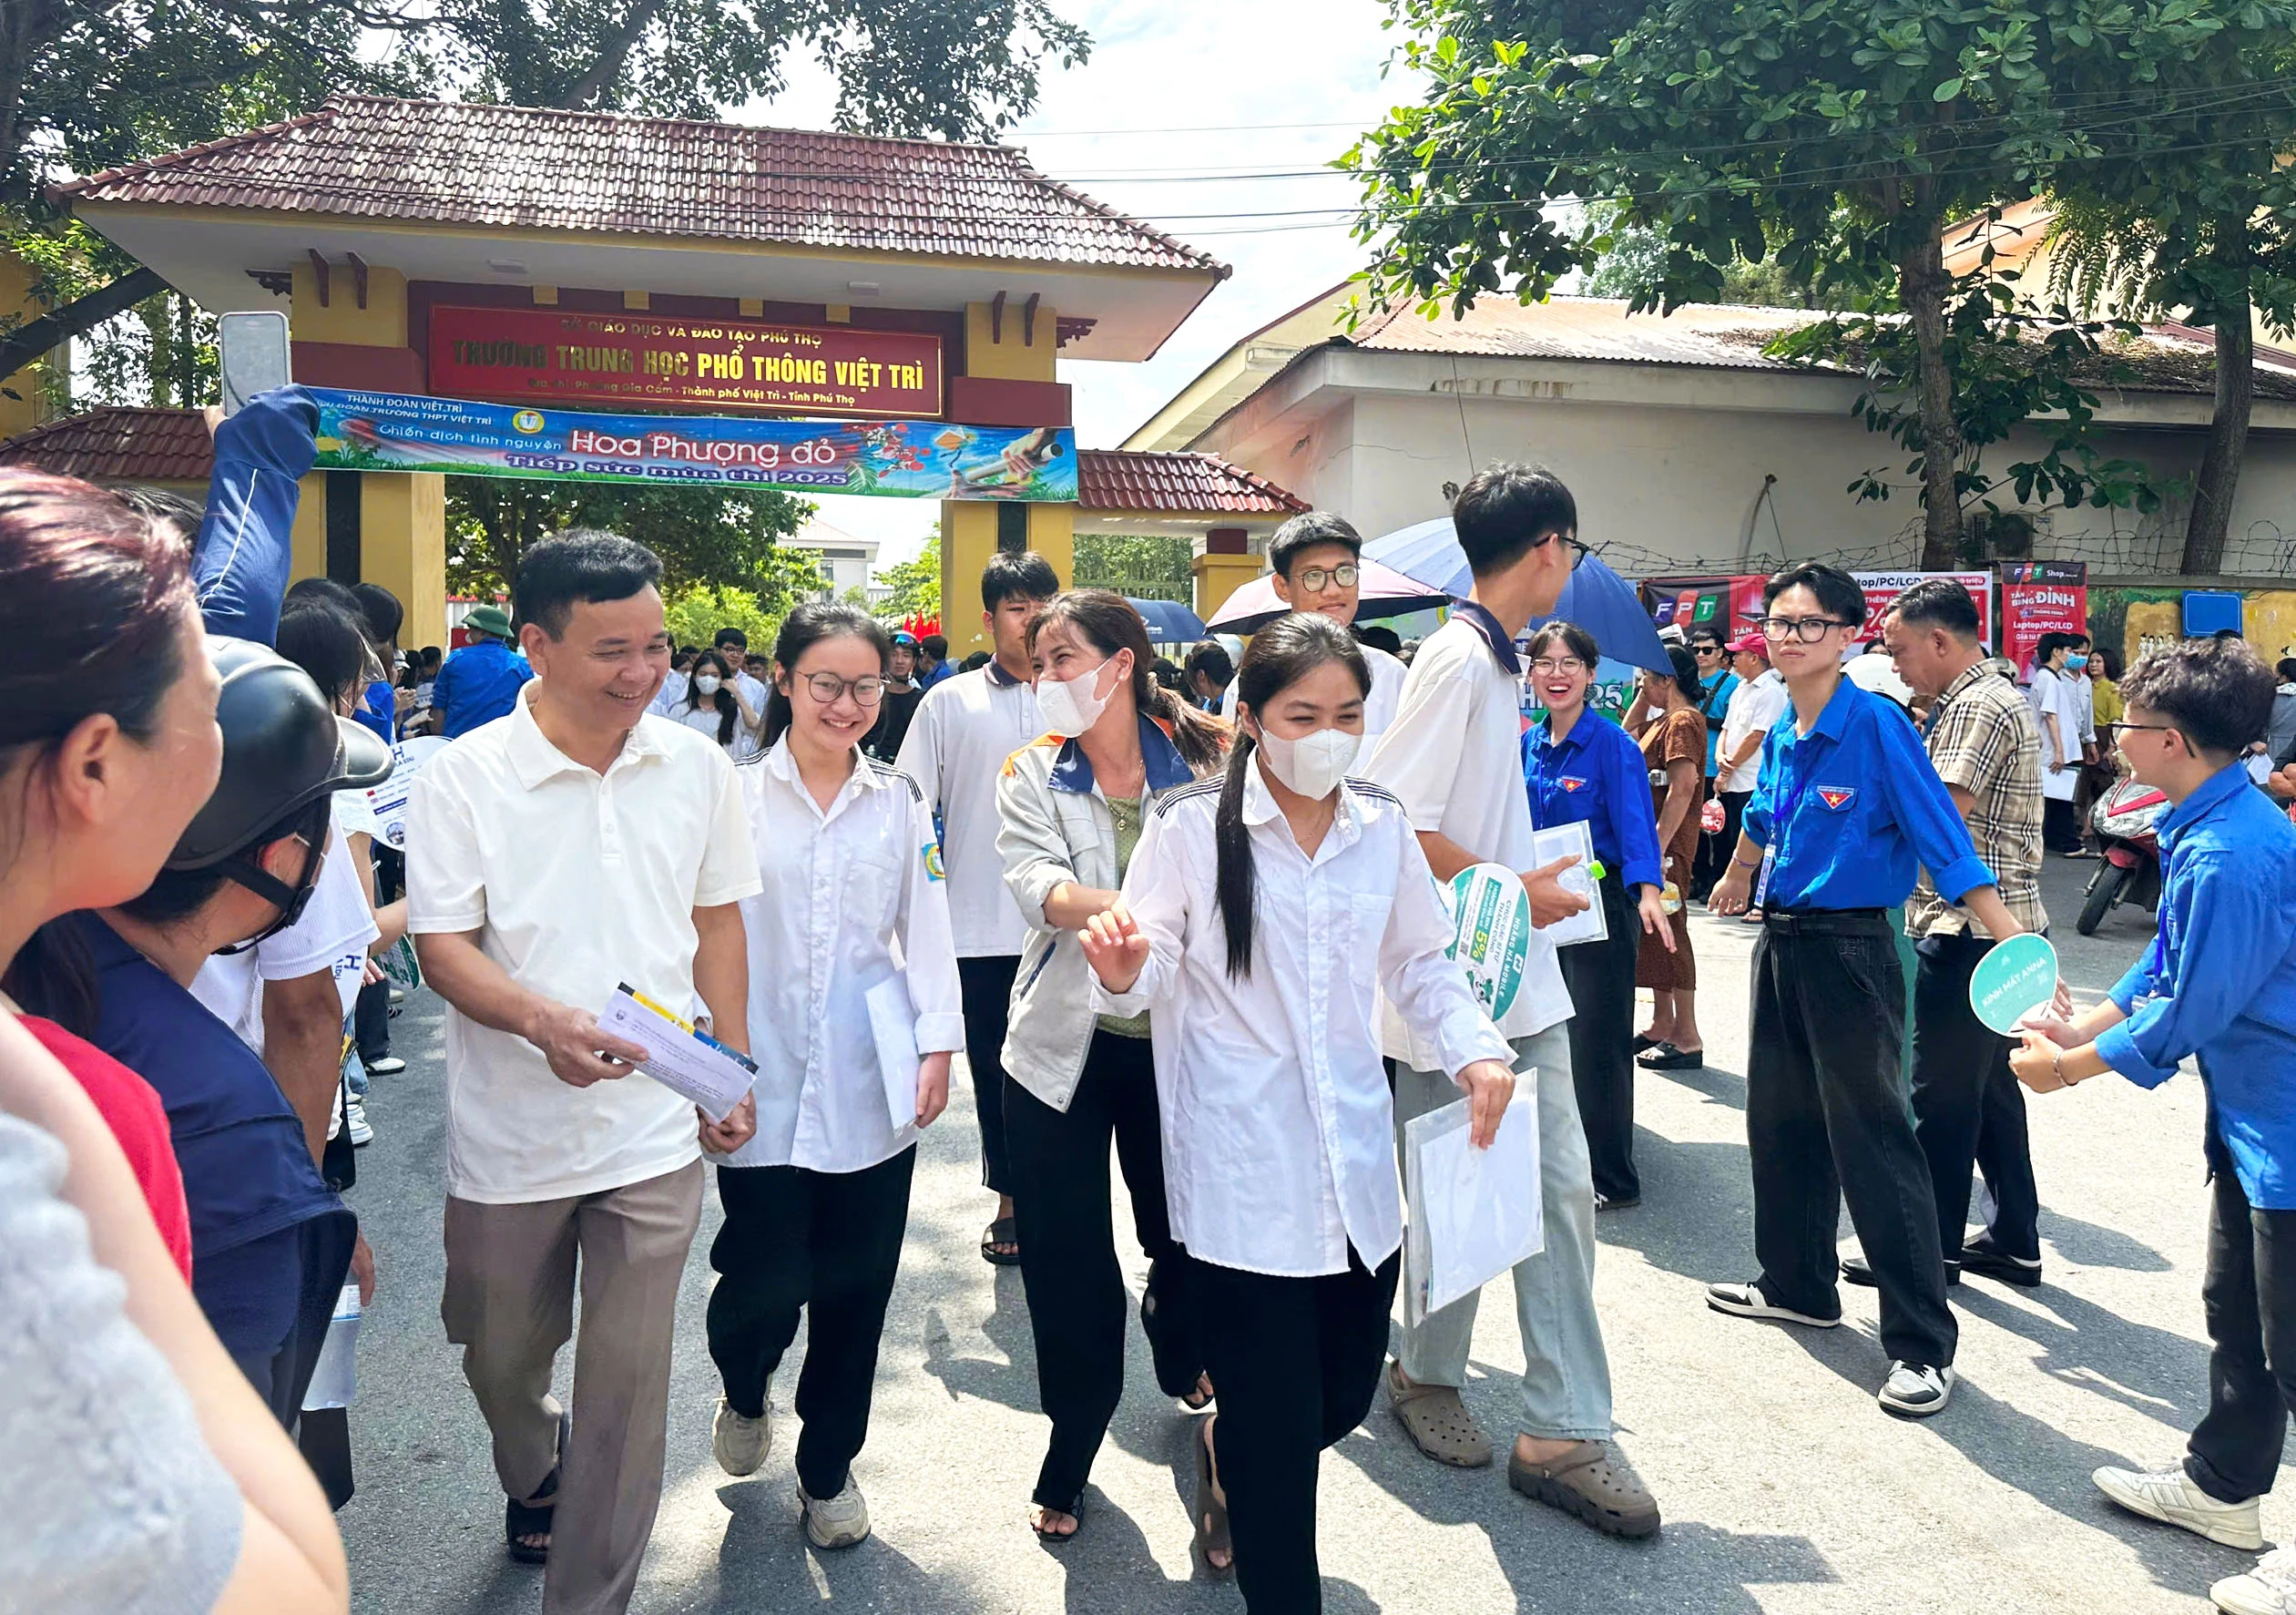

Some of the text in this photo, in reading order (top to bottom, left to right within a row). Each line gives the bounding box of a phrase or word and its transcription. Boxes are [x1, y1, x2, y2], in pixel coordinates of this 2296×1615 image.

[587, 320, 626, 333] GIÁO
[631, 324, 661, 339] DỤC
[667, 322, 687, 337] VÀ
[690, 324, 723, 339] ĐÀO
[729, 331, 756, 344] TẠO
[760, 329, 789, 344] PHÚ
[793, 333, 822, 349] THỌ
[453, 336, 924, 393] TRƯỜNG TRUNG HỌC PHỔ THÔNG VIỆT TRÌ
[347, 394, 463, 414] THÀNH ĐOÀN VIỆT TRÌ
[622, 382, 642, 393] Gia
[682, 384, 715, 398] Thành
[719, 386, 740, 401] phố
[743, 388, 764, 401] Việt
[767, 389, 781, 401] Trì
[789, 391, 811, 403] Tỉnh
[813, 392, 833, 404] Phú
[836, 394, 855, 405] Thọ
[337, 403, 369, 413] ĐOÀN
[372, 406, 419, 418] TRƯỜNG
[422, 412, 448, 422] THPT
[450, 414, 474, 424] VIỆT
[475, 416, 492, 425] TRÌ
[380, 424, 423, 438] Chiến
[430, 430, 464, 442] dịch
[471, 434, 499, 445] tình
[571, 429, 836, 469] Hoa Phượng đỏ
[506, 454, 848, 486] Tiếp sức mùa thi 2025
[2036, 587, 2076, 608] ĐỈNH
[2013, 620, 2074, 630] Laptop/PC/LCD
[1472, 930, 1488, 959] 5%
[1498, 916, 1521, 998] HOÀNG HÀ MOBILE
[2021, 956, 2046, 980] ANNA
[334, 965, 342, 980] EDU
